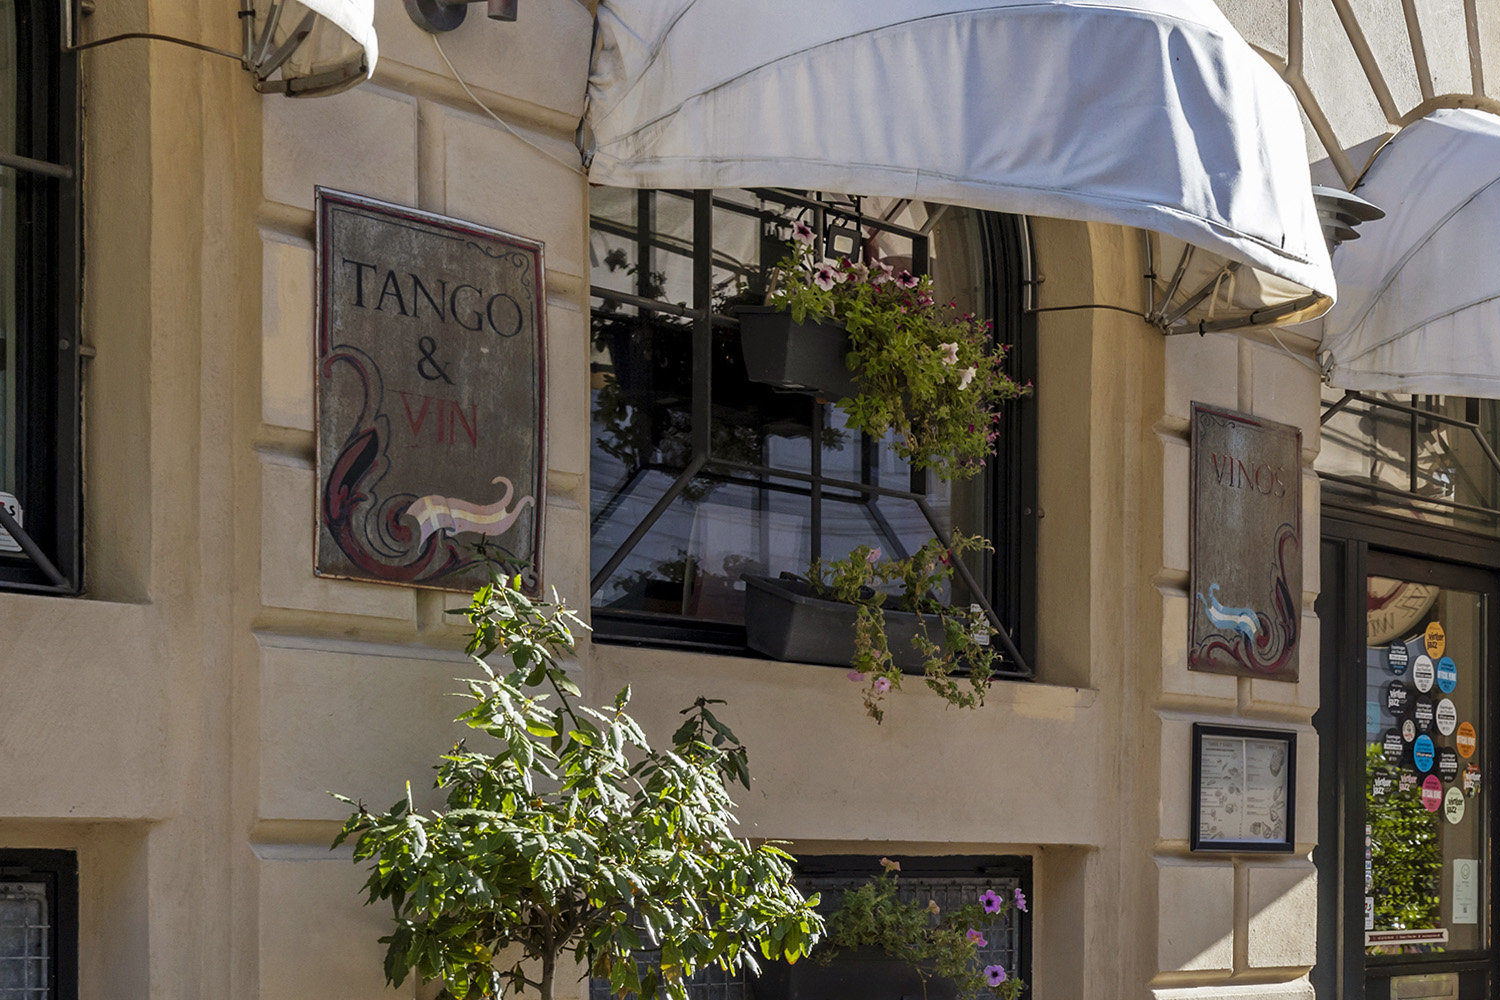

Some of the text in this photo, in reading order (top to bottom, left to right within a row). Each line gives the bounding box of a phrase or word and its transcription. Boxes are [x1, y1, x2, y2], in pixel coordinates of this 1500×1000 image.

[342, 257, 523, 338] TANGO
[416, 335, 455, 385] &
[400, 391, 478, 448] VIN
[1211, 452, 1285, 498] VINOS
